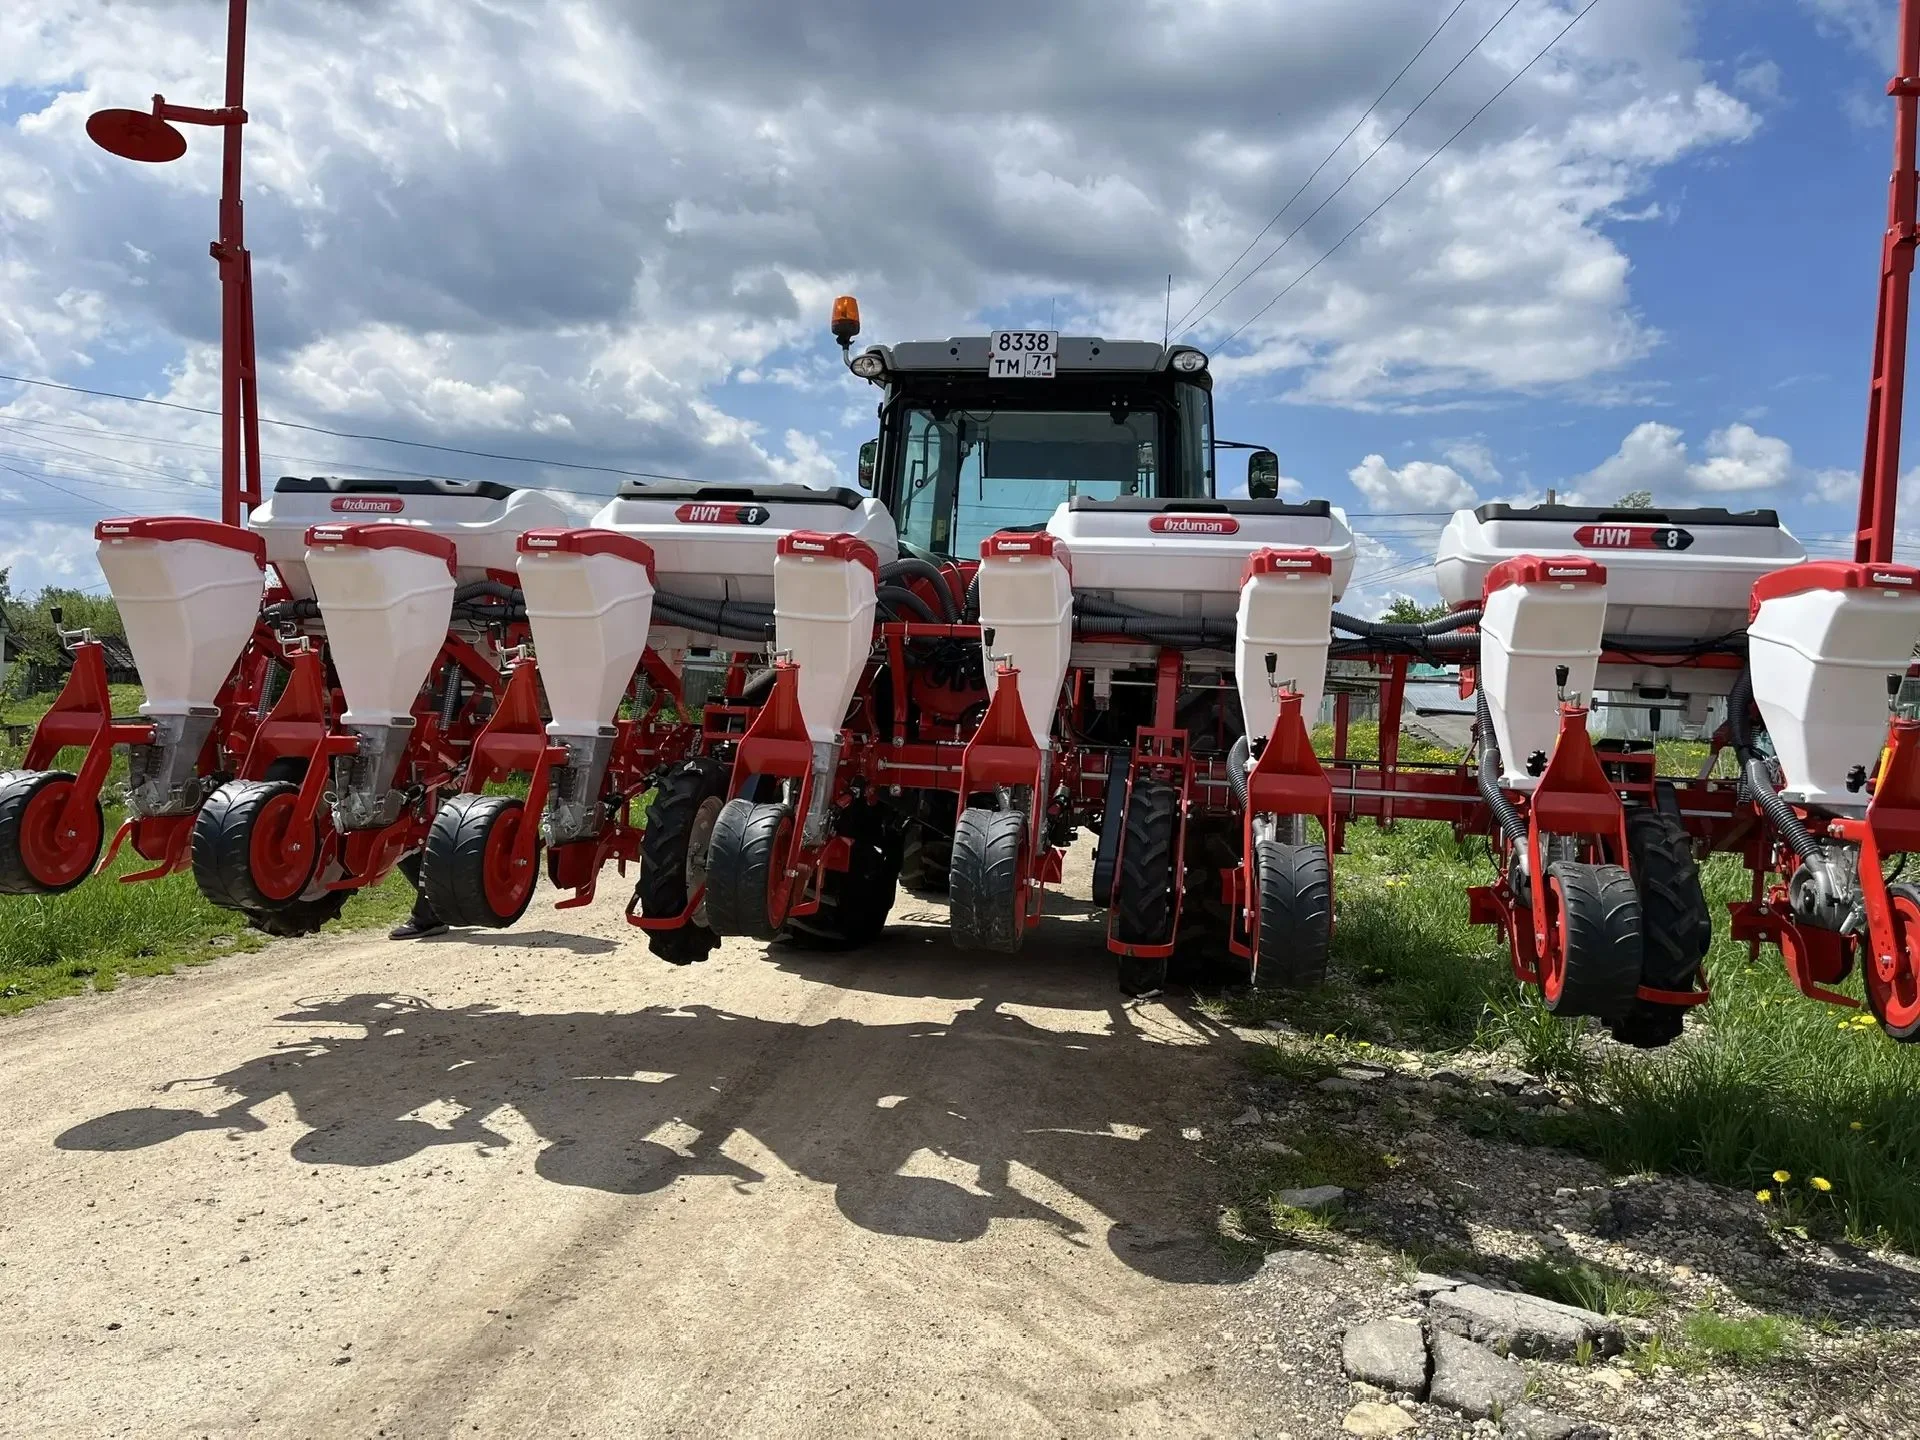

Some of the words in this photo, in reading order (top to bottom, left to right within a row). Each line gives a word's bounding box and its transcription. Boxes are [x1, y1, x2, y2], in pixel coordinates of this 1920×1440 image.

[999, 333, 1049, 351] 8338
[995, 359, 1020, 374] TM
[1032, 355, 1051, 370] 71
[689, 506, 721, 521] HVM
[747, 508, 758, 523] 8
[1592, 528, 1631, 545] HVM
[1666, 530, 1679, 548] 8
